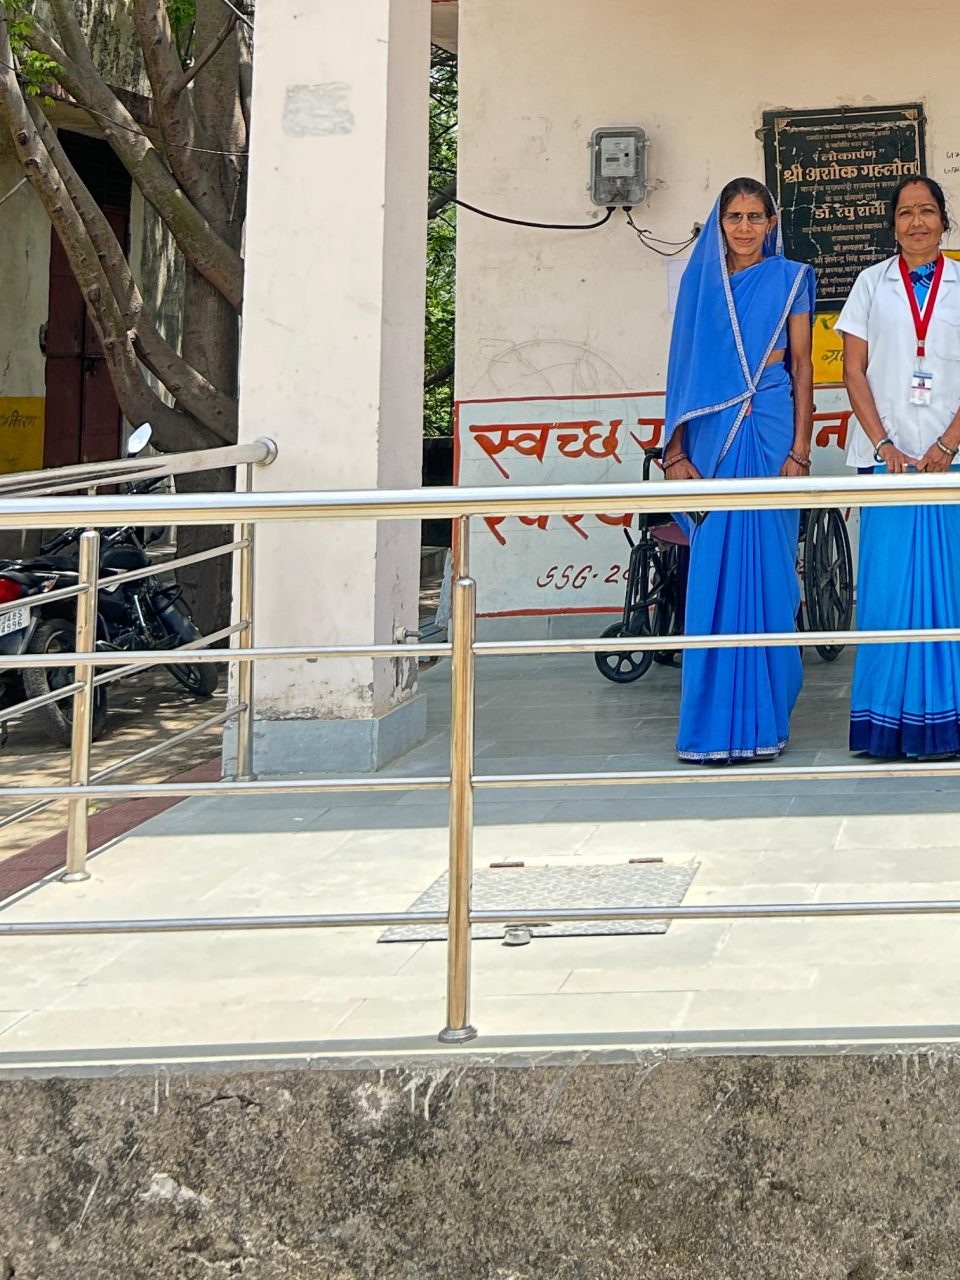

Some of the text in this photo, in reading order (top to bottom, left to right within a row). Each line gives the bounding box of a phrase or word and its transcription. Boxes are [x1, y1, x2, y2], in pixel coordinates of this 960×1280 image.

[783, 158, 917, 184] श्री अशोक गहलोत
[469, 419, 623, 479] स्वच्छ
